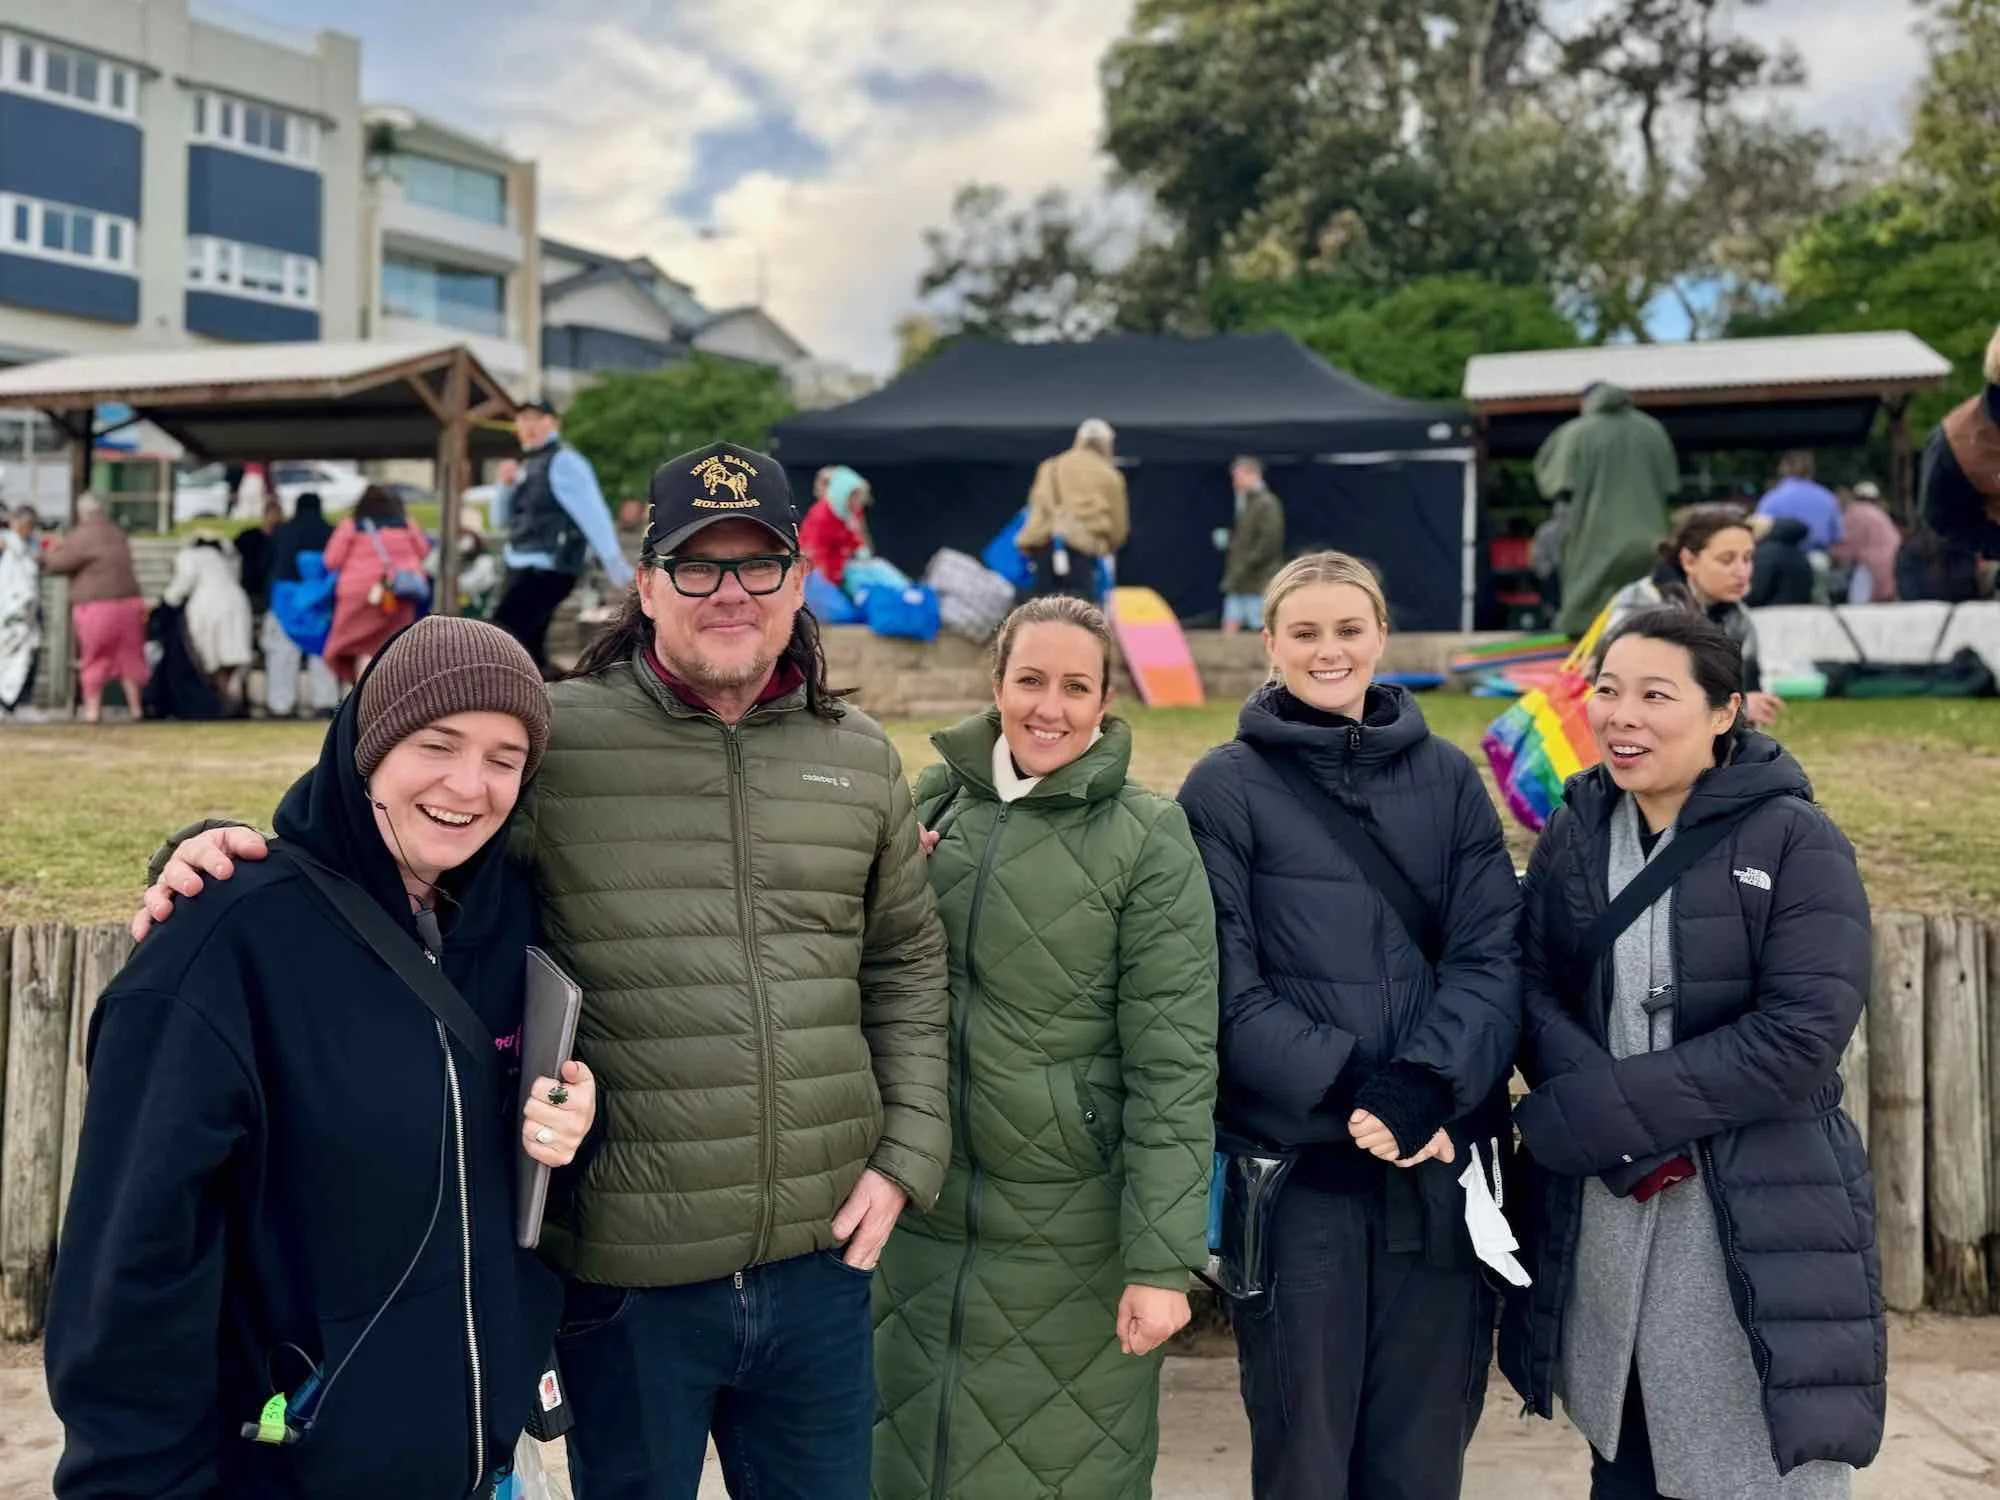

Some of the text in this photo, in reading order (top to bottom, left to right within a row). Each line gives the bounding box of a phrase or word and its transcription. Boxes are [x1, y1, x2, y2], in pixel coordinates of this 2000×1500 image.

[690, 455, 758, 476] IRON BARK
[691, 498, 761, 509] HOLDINGS
